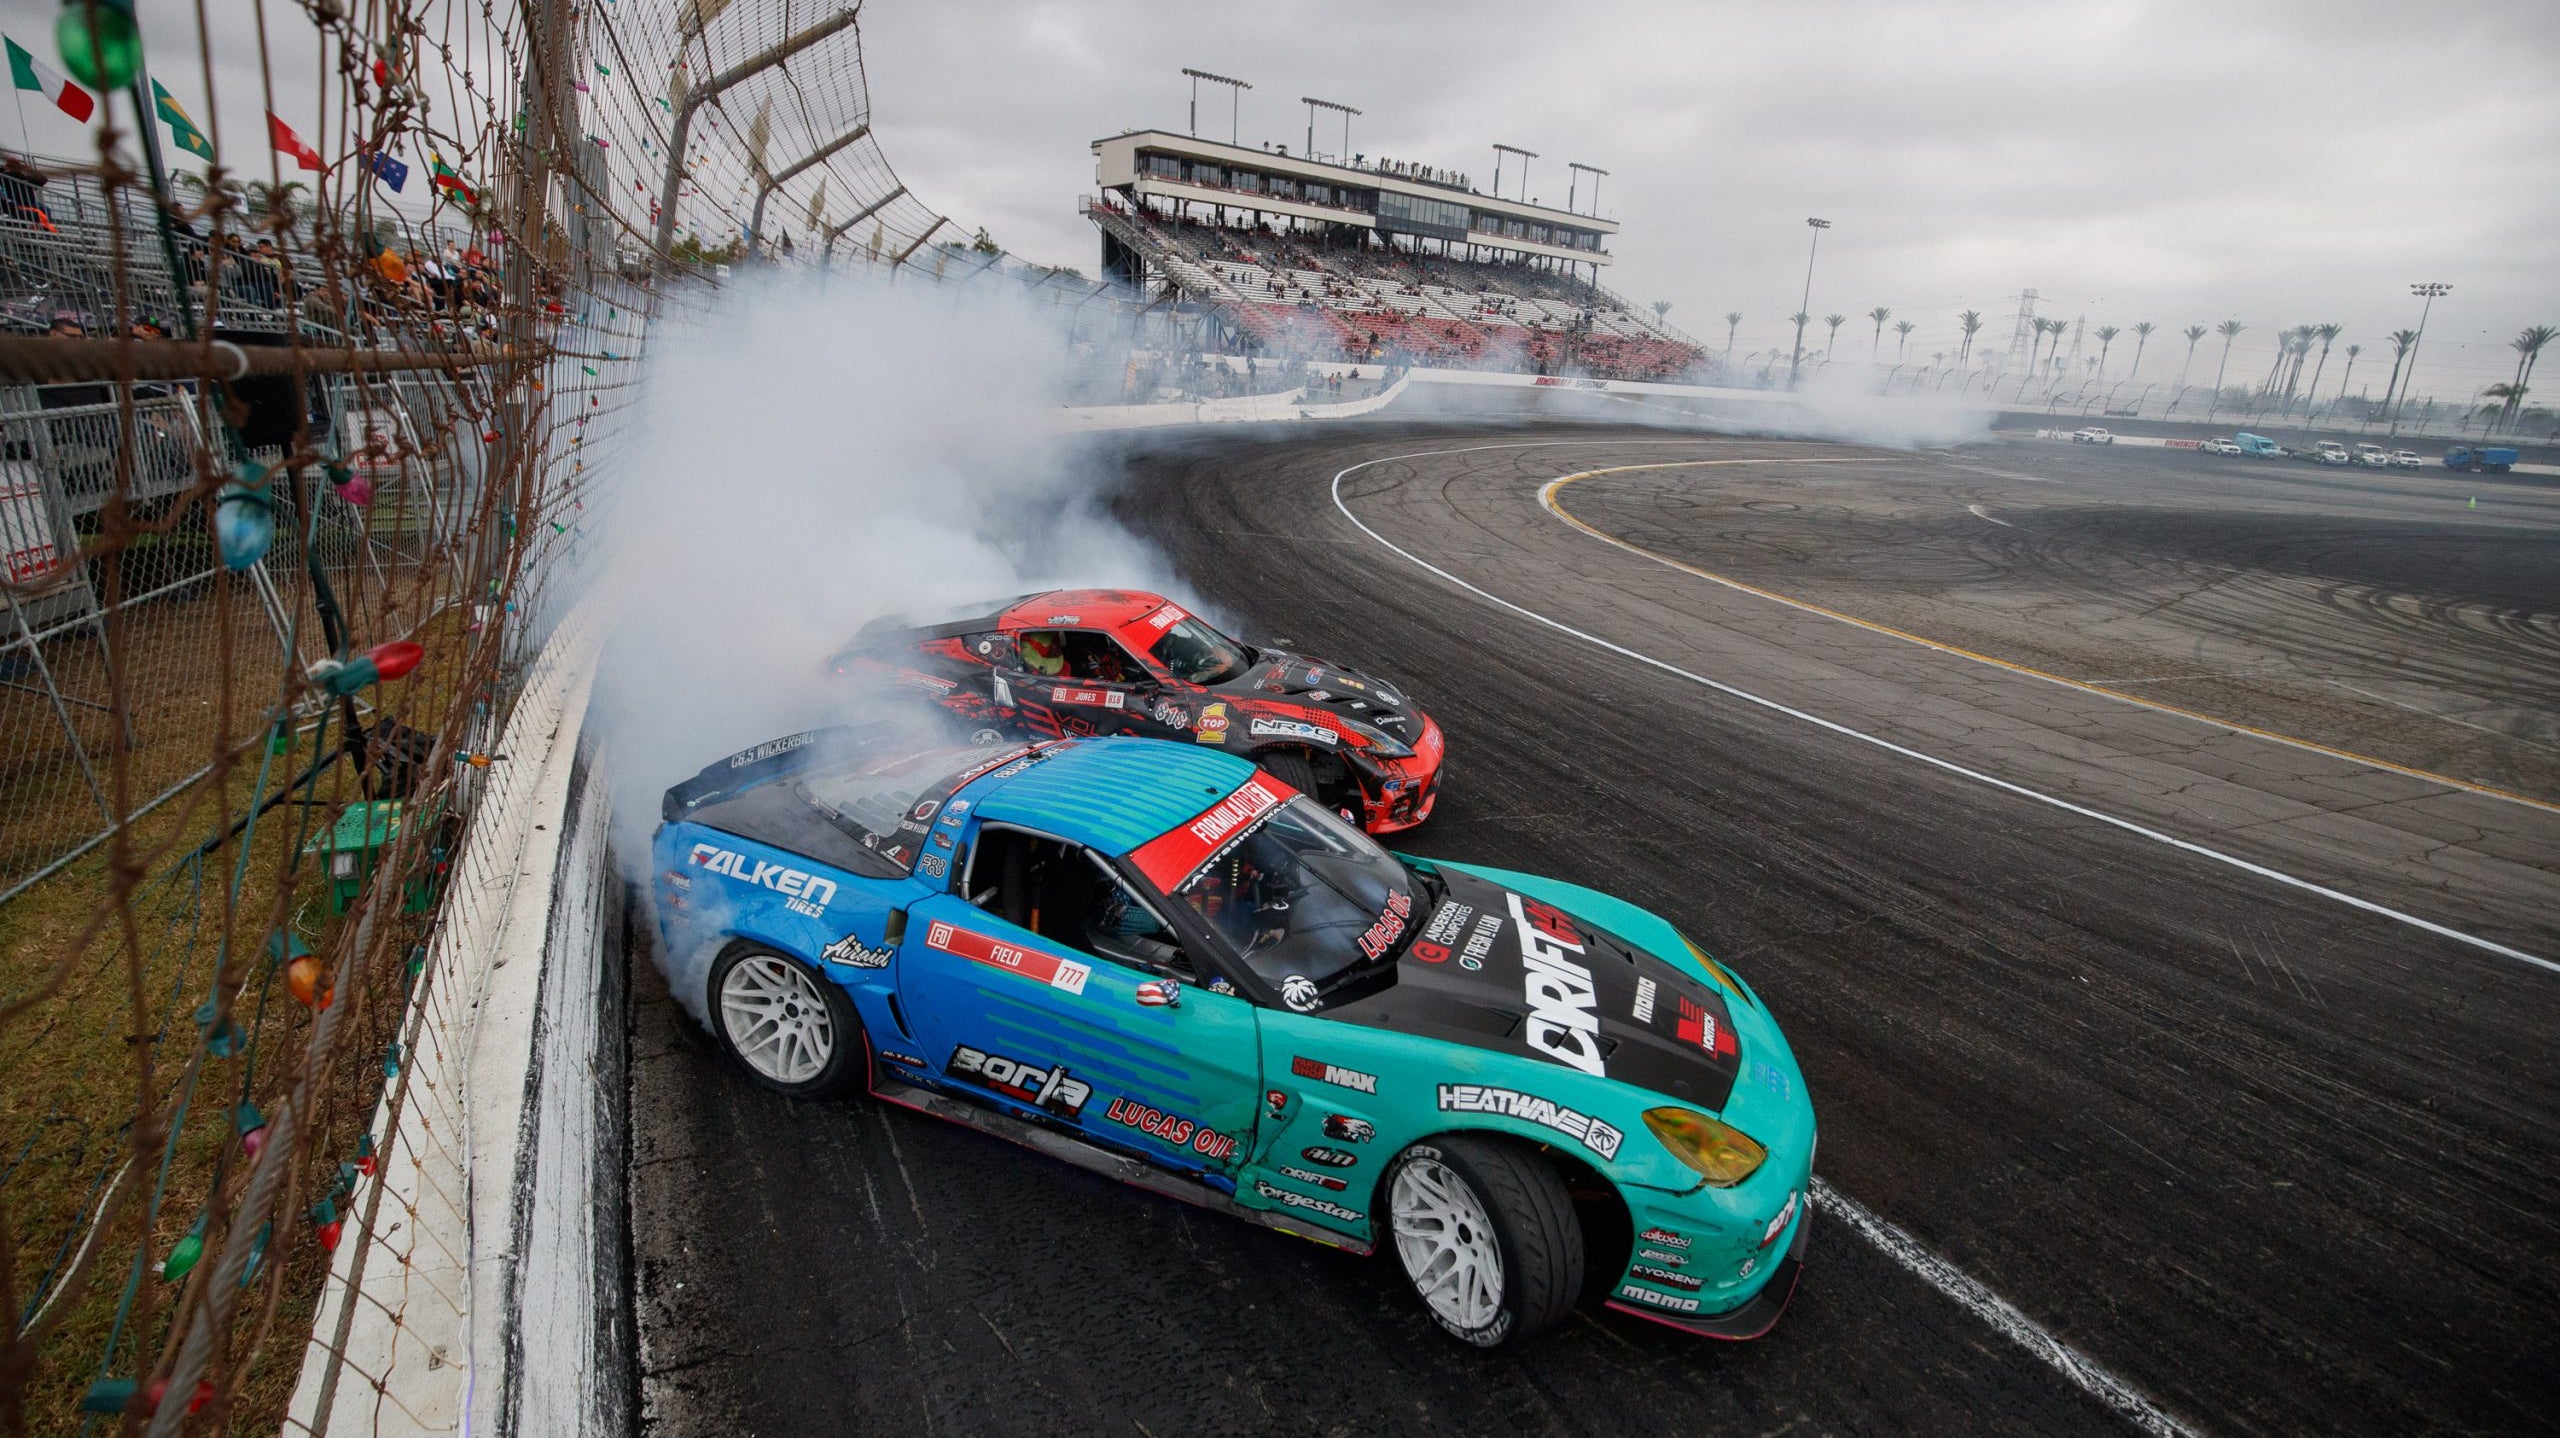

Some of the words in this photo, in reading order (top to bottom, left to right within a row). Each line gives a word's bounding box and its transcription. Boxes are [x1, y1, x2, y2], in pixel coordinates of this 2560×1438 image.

[1075, 692, 1097, 701] JONES
[1202, 718, 1226, 728] TOP
[731, 751, 754, 769] C6.5
[756, 732, 815, 760] WICKERBILL
[688, 843, 837, 906] FALKEN
[785, 896, 825, 918] TIRES
[1358, 908, 1405, 960] LUCAS
[1387, 888, 1411, 918] OIL
[1425, 900, 1460, 942] ANDERSON
[1440, 904, 1473, 946] COMPOSITES
[990, 944, 1023, 967] FIELD
[1059, 966, 1084, 986] 777
[1464, 933, 1494, 959] FRESH
[1506, 892, 1606, 1078] DRIFT
[1324, 1064, 1378, 1094] MAX
[1106, 1097, 1194, 1145] LUCAS
[1193, 1128, 1239, 1159] OIL
[1439, 1085, 1590, 1140] HEATWAVE
[1632, 1264, 1705, 1286] KYORENE
